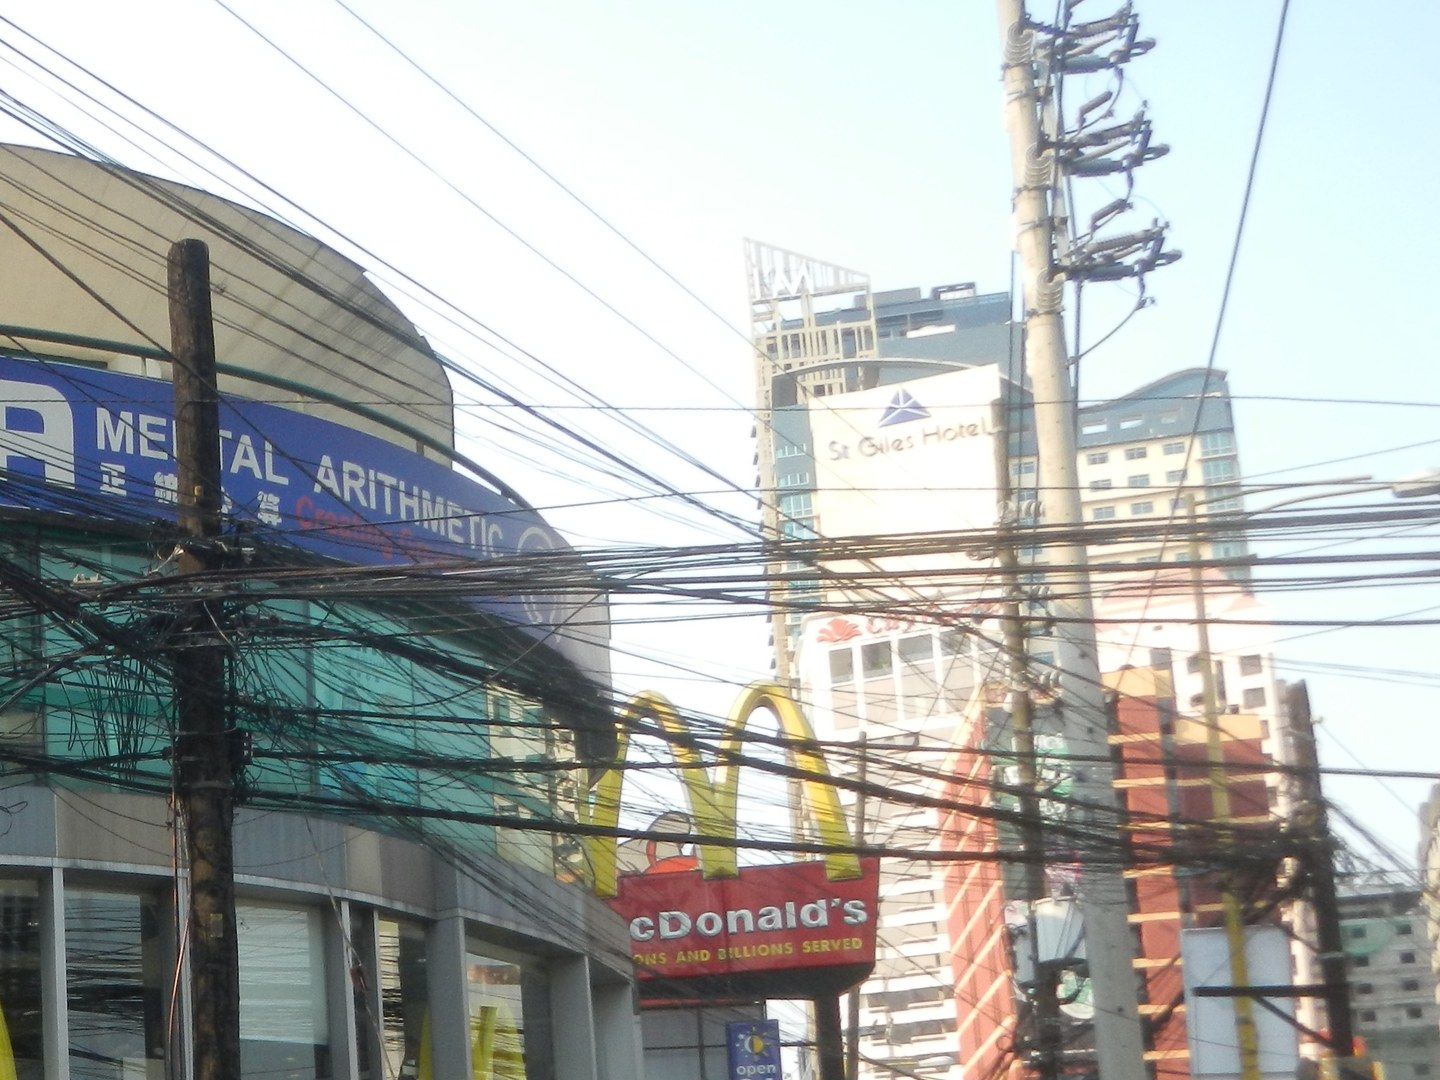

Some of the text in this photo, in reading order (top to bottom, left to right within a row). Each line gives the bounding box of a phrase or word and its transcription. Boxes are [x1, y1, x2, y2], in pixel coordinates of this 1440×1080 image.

[828, 440, 850, 461] St
[96, 407, 504, 560] MEAL ARITHMETIC
[676, 949, 712, 964] AND
[717, 942, 794, 961] BILLIONS
[802, 937, 863, 953] SERVED
